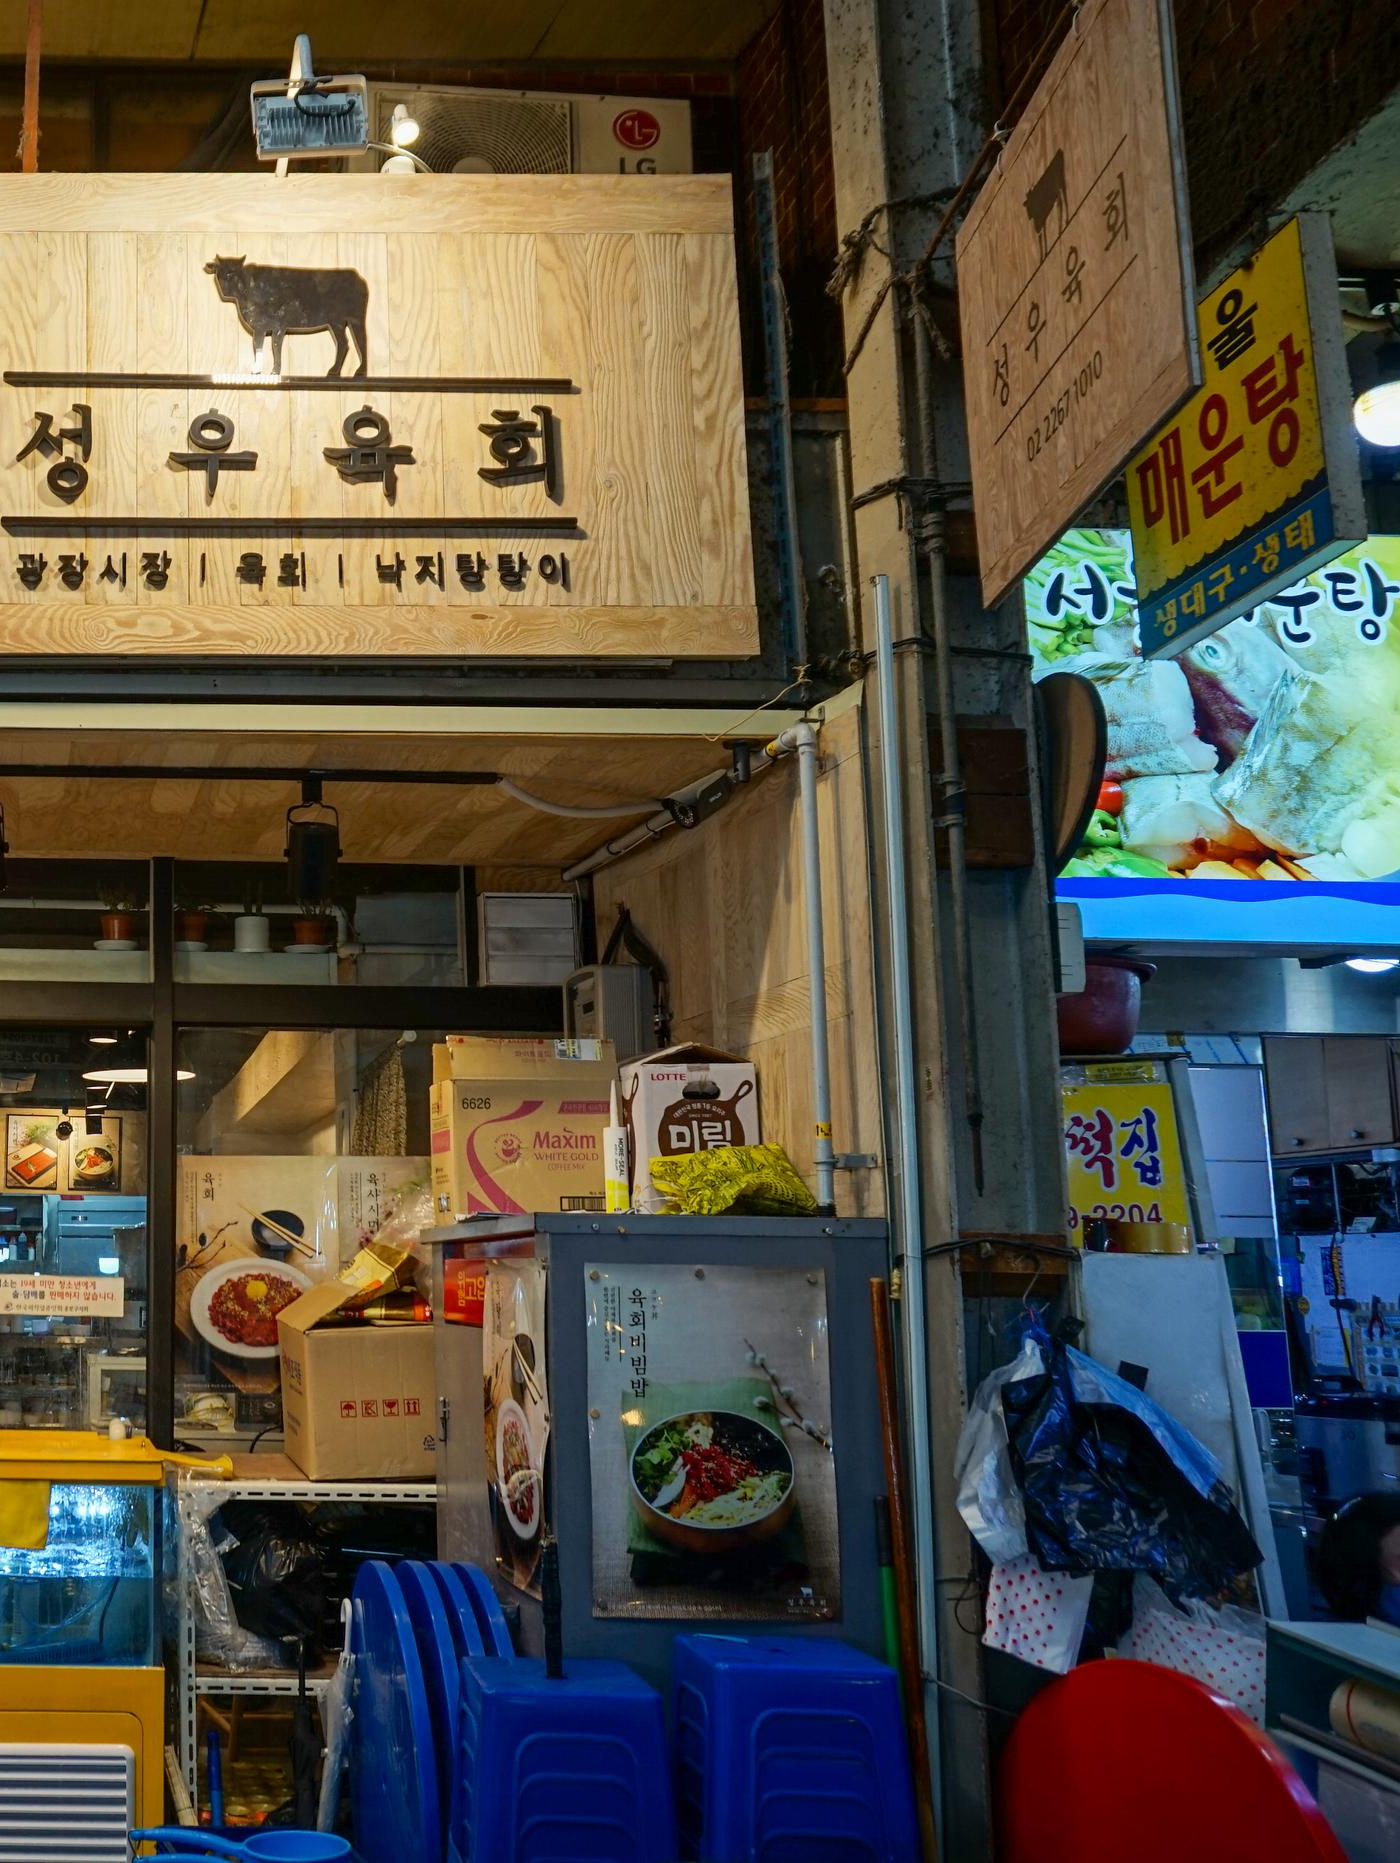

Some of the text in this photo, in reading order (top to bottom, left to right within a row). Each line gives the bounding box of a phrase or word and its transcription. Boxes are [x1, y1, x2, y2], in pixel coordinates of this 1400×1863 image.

[993, 172, 1129, 407] 성우육회
[1027, 350, 1103, 462] 02 2267 1010
[15, 403, 557, 499] 성우육회
[1136, 333, 1305, 545] 매운탕
[16, 550, 568, 591] 광장시장 육회 낙지탕탕이
[650, 1073, 687, 1081] LOTTE
[461, 1097, 492, 1110] 6626
[533, 1128, 596, 1149] Maxim
[668, 1120, 732, 1153] 미림
[534, 1152, 599, 1161] WHITE GOLD
[200, 1172, 215, 1201] 육회
[39, 1280, 55, 1289] 미만
[628, 1287, 649, 1398] 육회비빔밥
